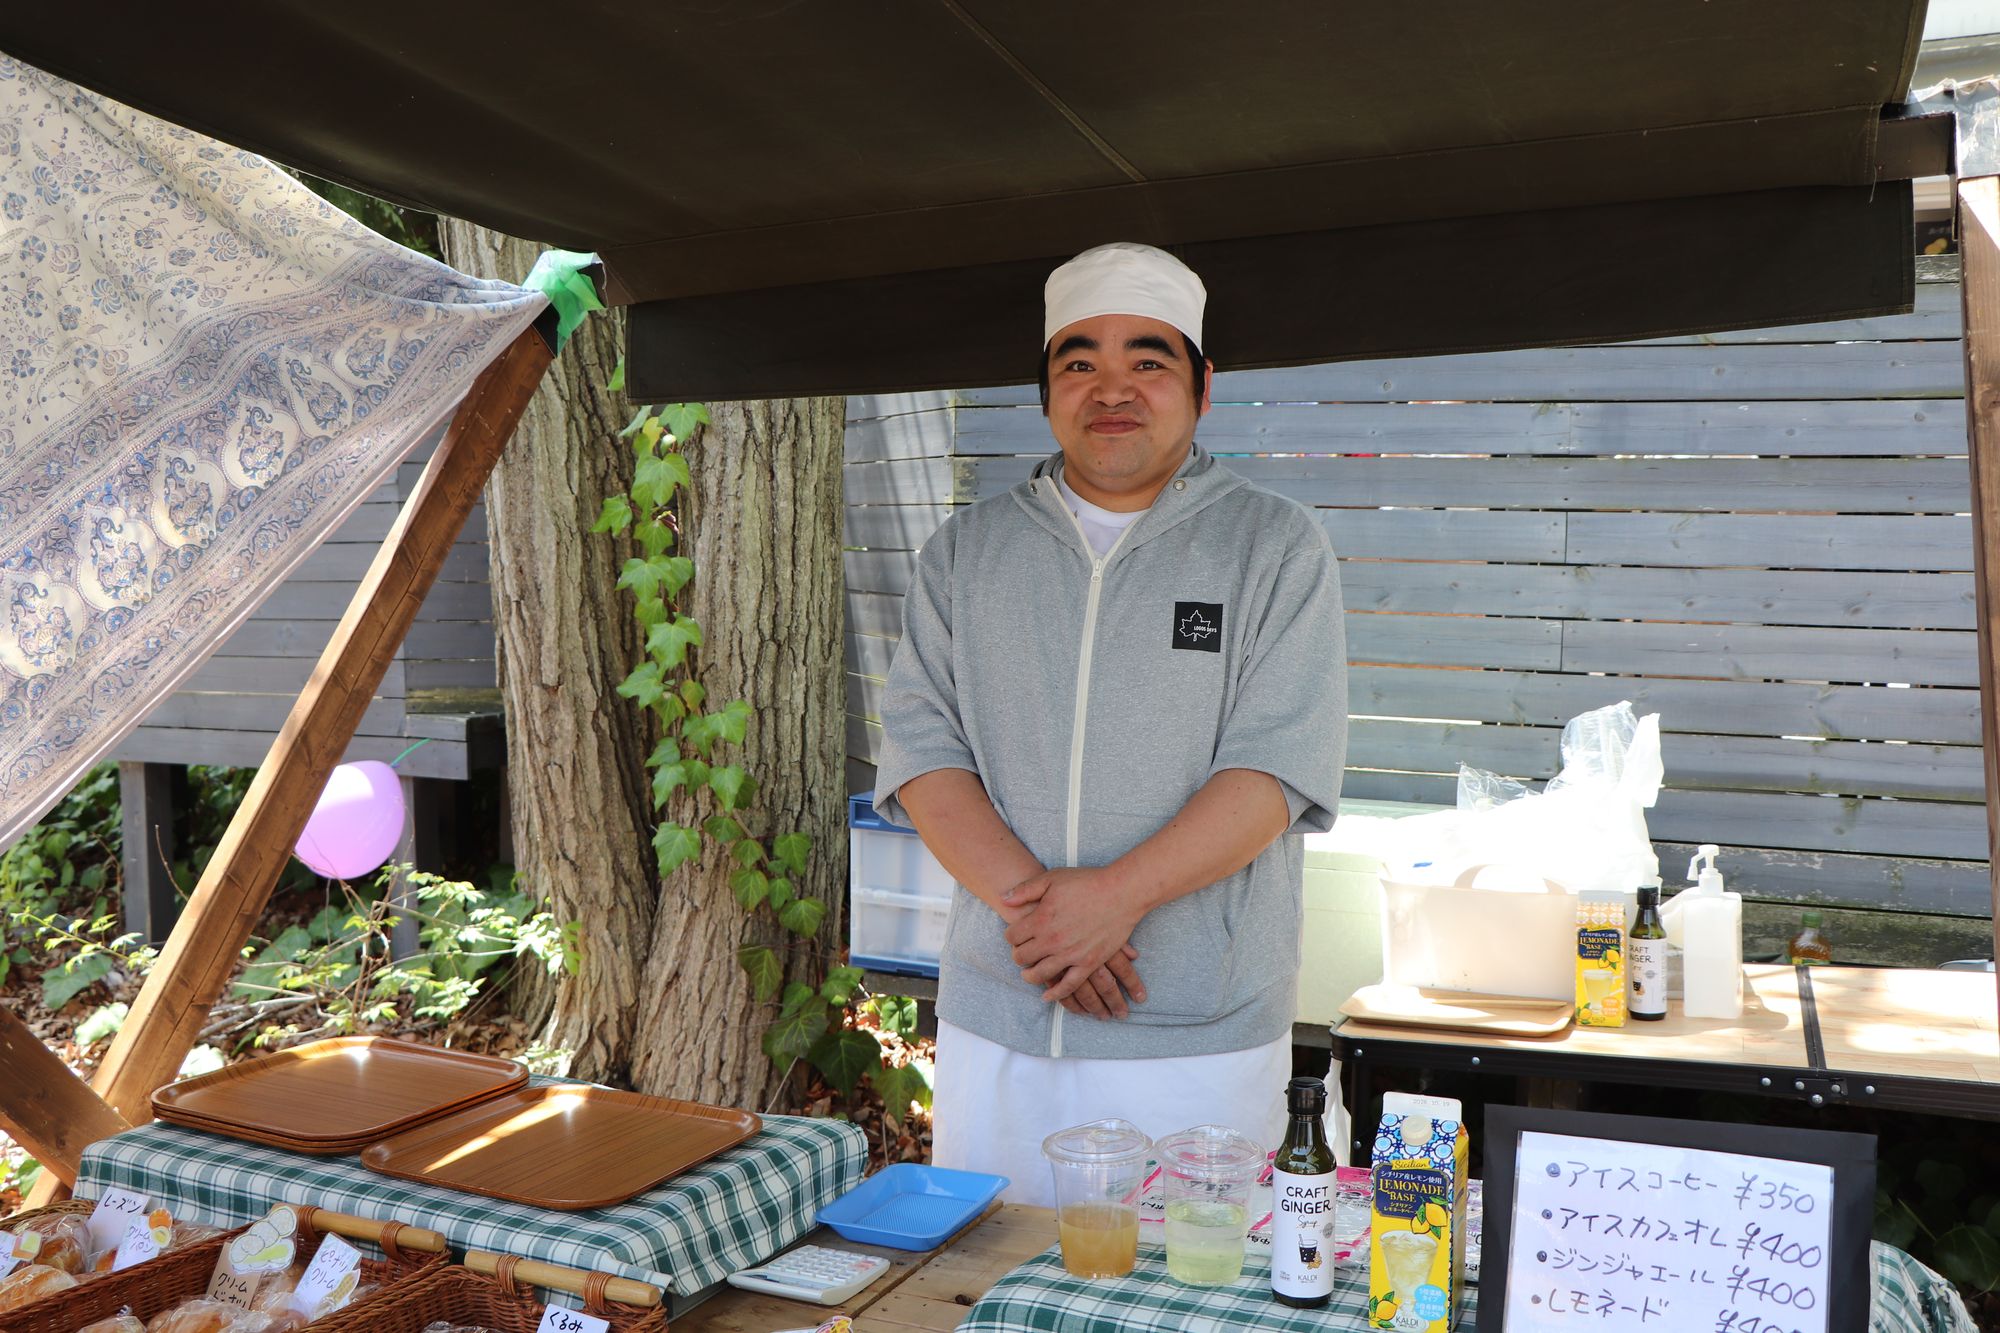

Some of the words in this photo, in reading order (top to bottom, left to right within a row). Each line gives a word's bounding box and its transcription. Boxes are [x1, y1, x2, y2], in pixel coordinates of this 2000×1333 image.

[1394, 1160, 1428, 1169] Sicilian
[1380, 1170, 1442, 1184] シチリア産レモン使用
[1286, 1186, 1329, 1198] CRAFT
[1378, 1178, 1445, 1196] LEMONADE
[1567, 1160, 1717, 1192] アイスコーヒー
[1733, 1171, 1814, 1214] ¥350
[104, 1194, 142, 1213] レーズン
[1281, 1199, 1332, 1214] GINGER
[1389, 1192, 1417, 1203] BASE
[1297, 1215, 1318, 1228] Syrup
[1560, 1208, 1727, 1247] アイスカフェオレ
[1736, 1222, 1822, 1268] ¥400
[217, 1272, 247, 1293] クリーム
[311, 1268, 336, 1290] クリーム
[1552, 1248, 1715, 1284] ジンジャエール
[1727, 1265, 1816, 1310] ¥400
[1549, 1288, 1669, 1323] レモネード
[549, 1311, 584, 1333] くるみ
[1395, 1316, 1419, 1327] KALDI
